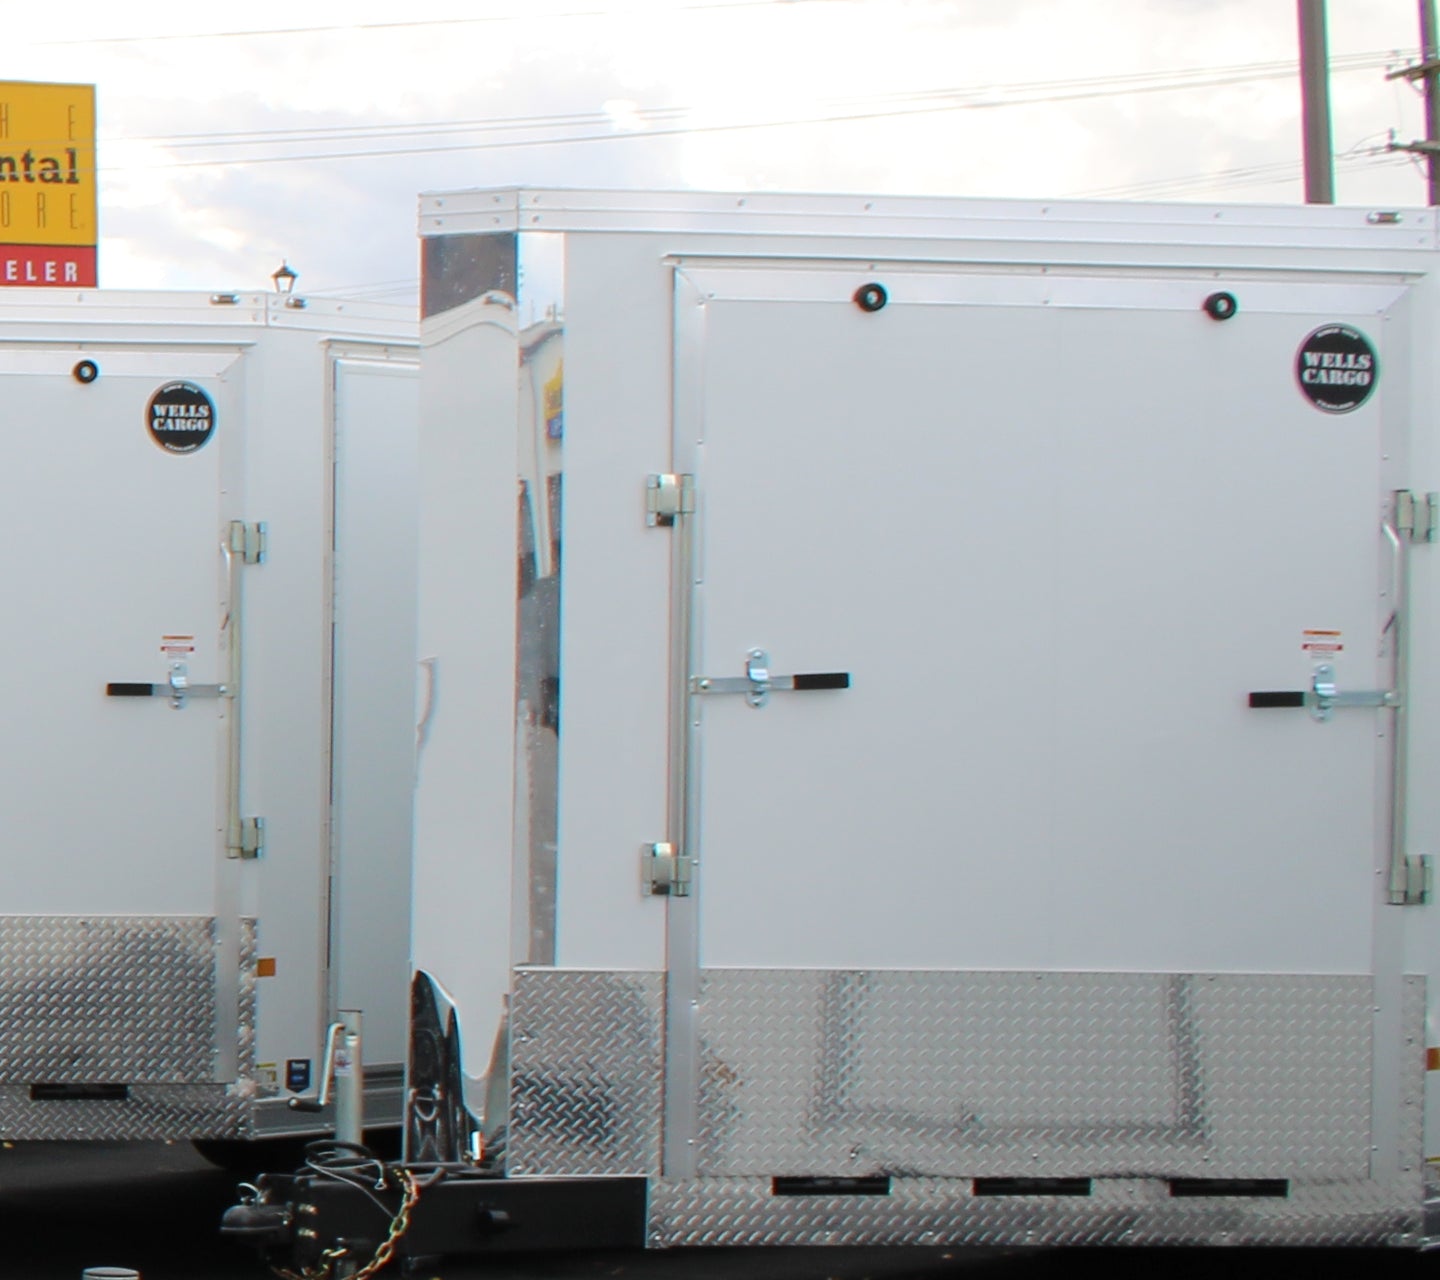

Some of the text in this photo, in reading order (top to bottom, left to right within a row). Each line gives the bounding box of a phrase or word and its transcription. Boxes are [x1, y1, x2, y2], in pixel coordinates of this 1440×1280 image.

[0, 102, 75, 141] HE
[1303, 351, 1372, 370] WELLS
[1302, 367, 1372, 386] CARGO
[153, 404, 210, 418] WELLS
[152, 418, 210, 431] CARGO
